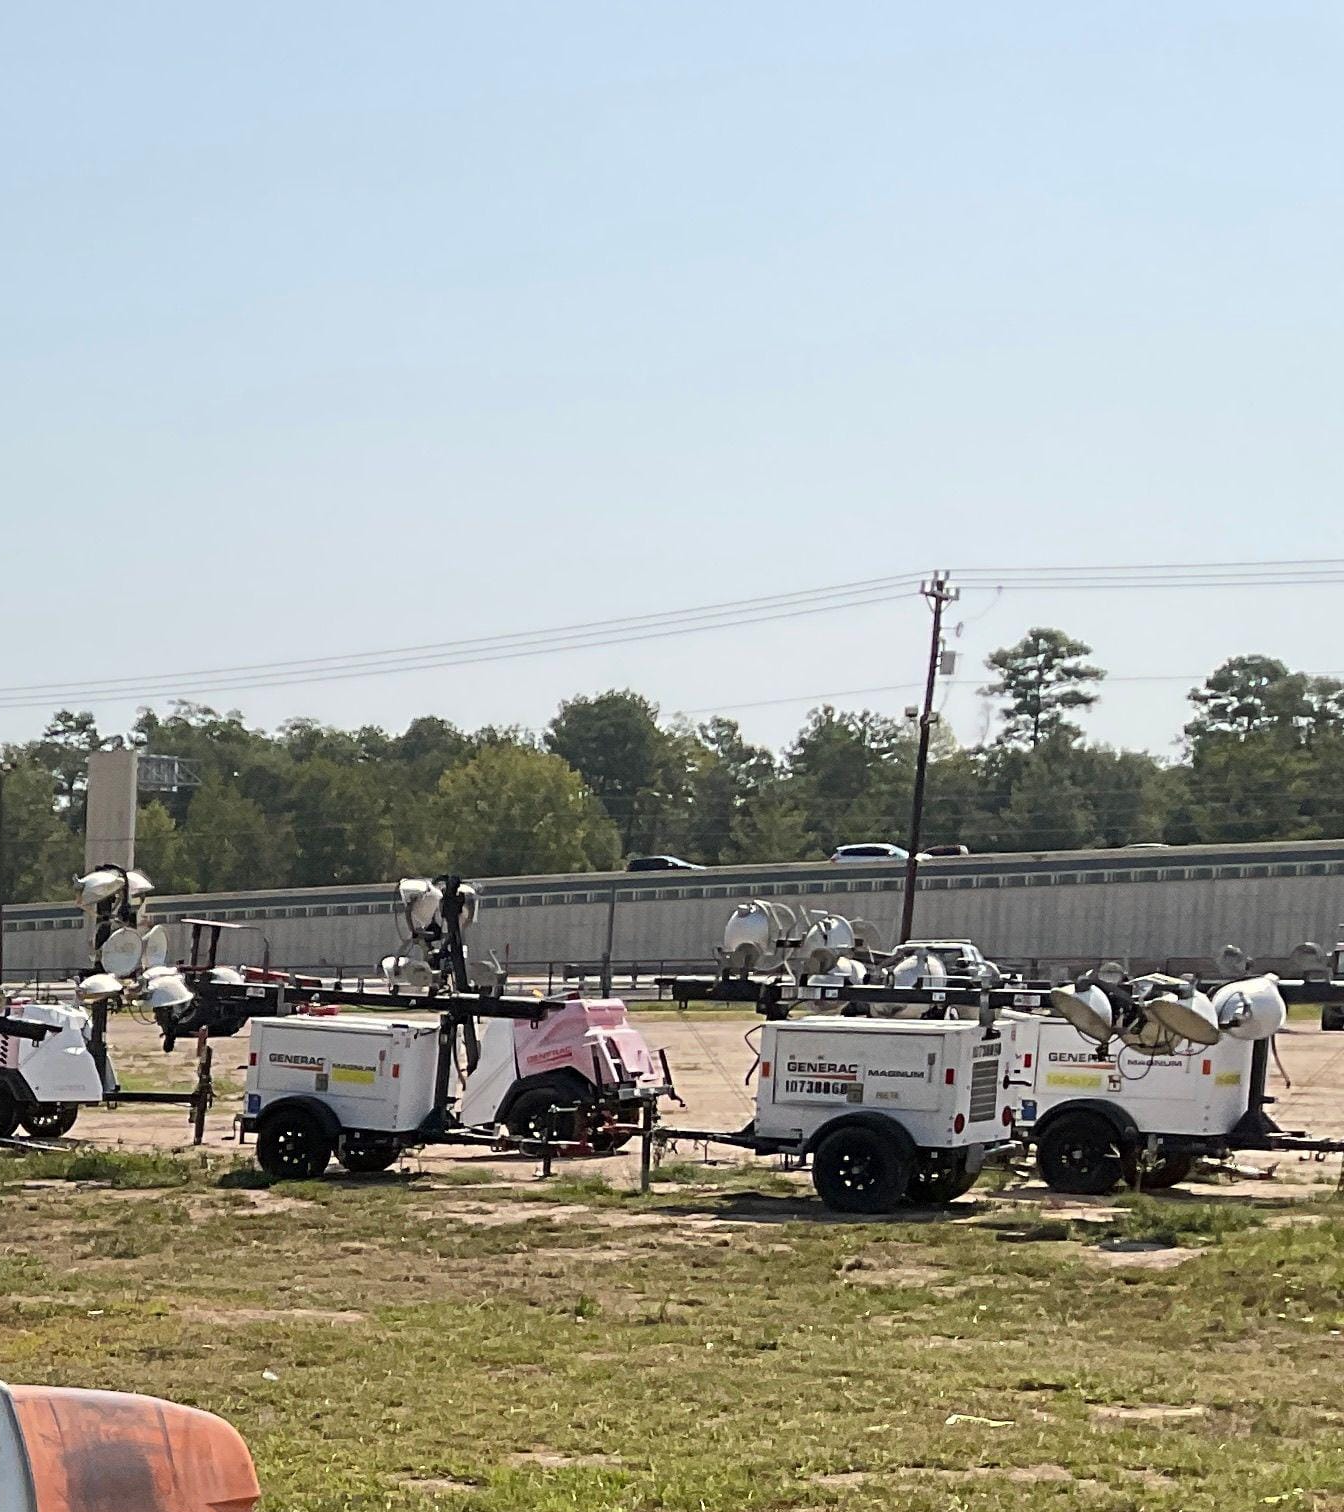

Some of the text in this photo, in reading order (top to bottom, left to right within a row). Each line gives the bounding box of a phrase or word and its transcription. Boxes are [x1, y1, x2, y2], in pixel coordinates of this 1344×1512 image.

[269, 1053, 326, 1066] GENERAC
[332, 1063, 377, 1073] MAGNUM
[787, 1061, 858, 1074] GENERAC
[867, 1069, 925, 1079] MAGNUM
